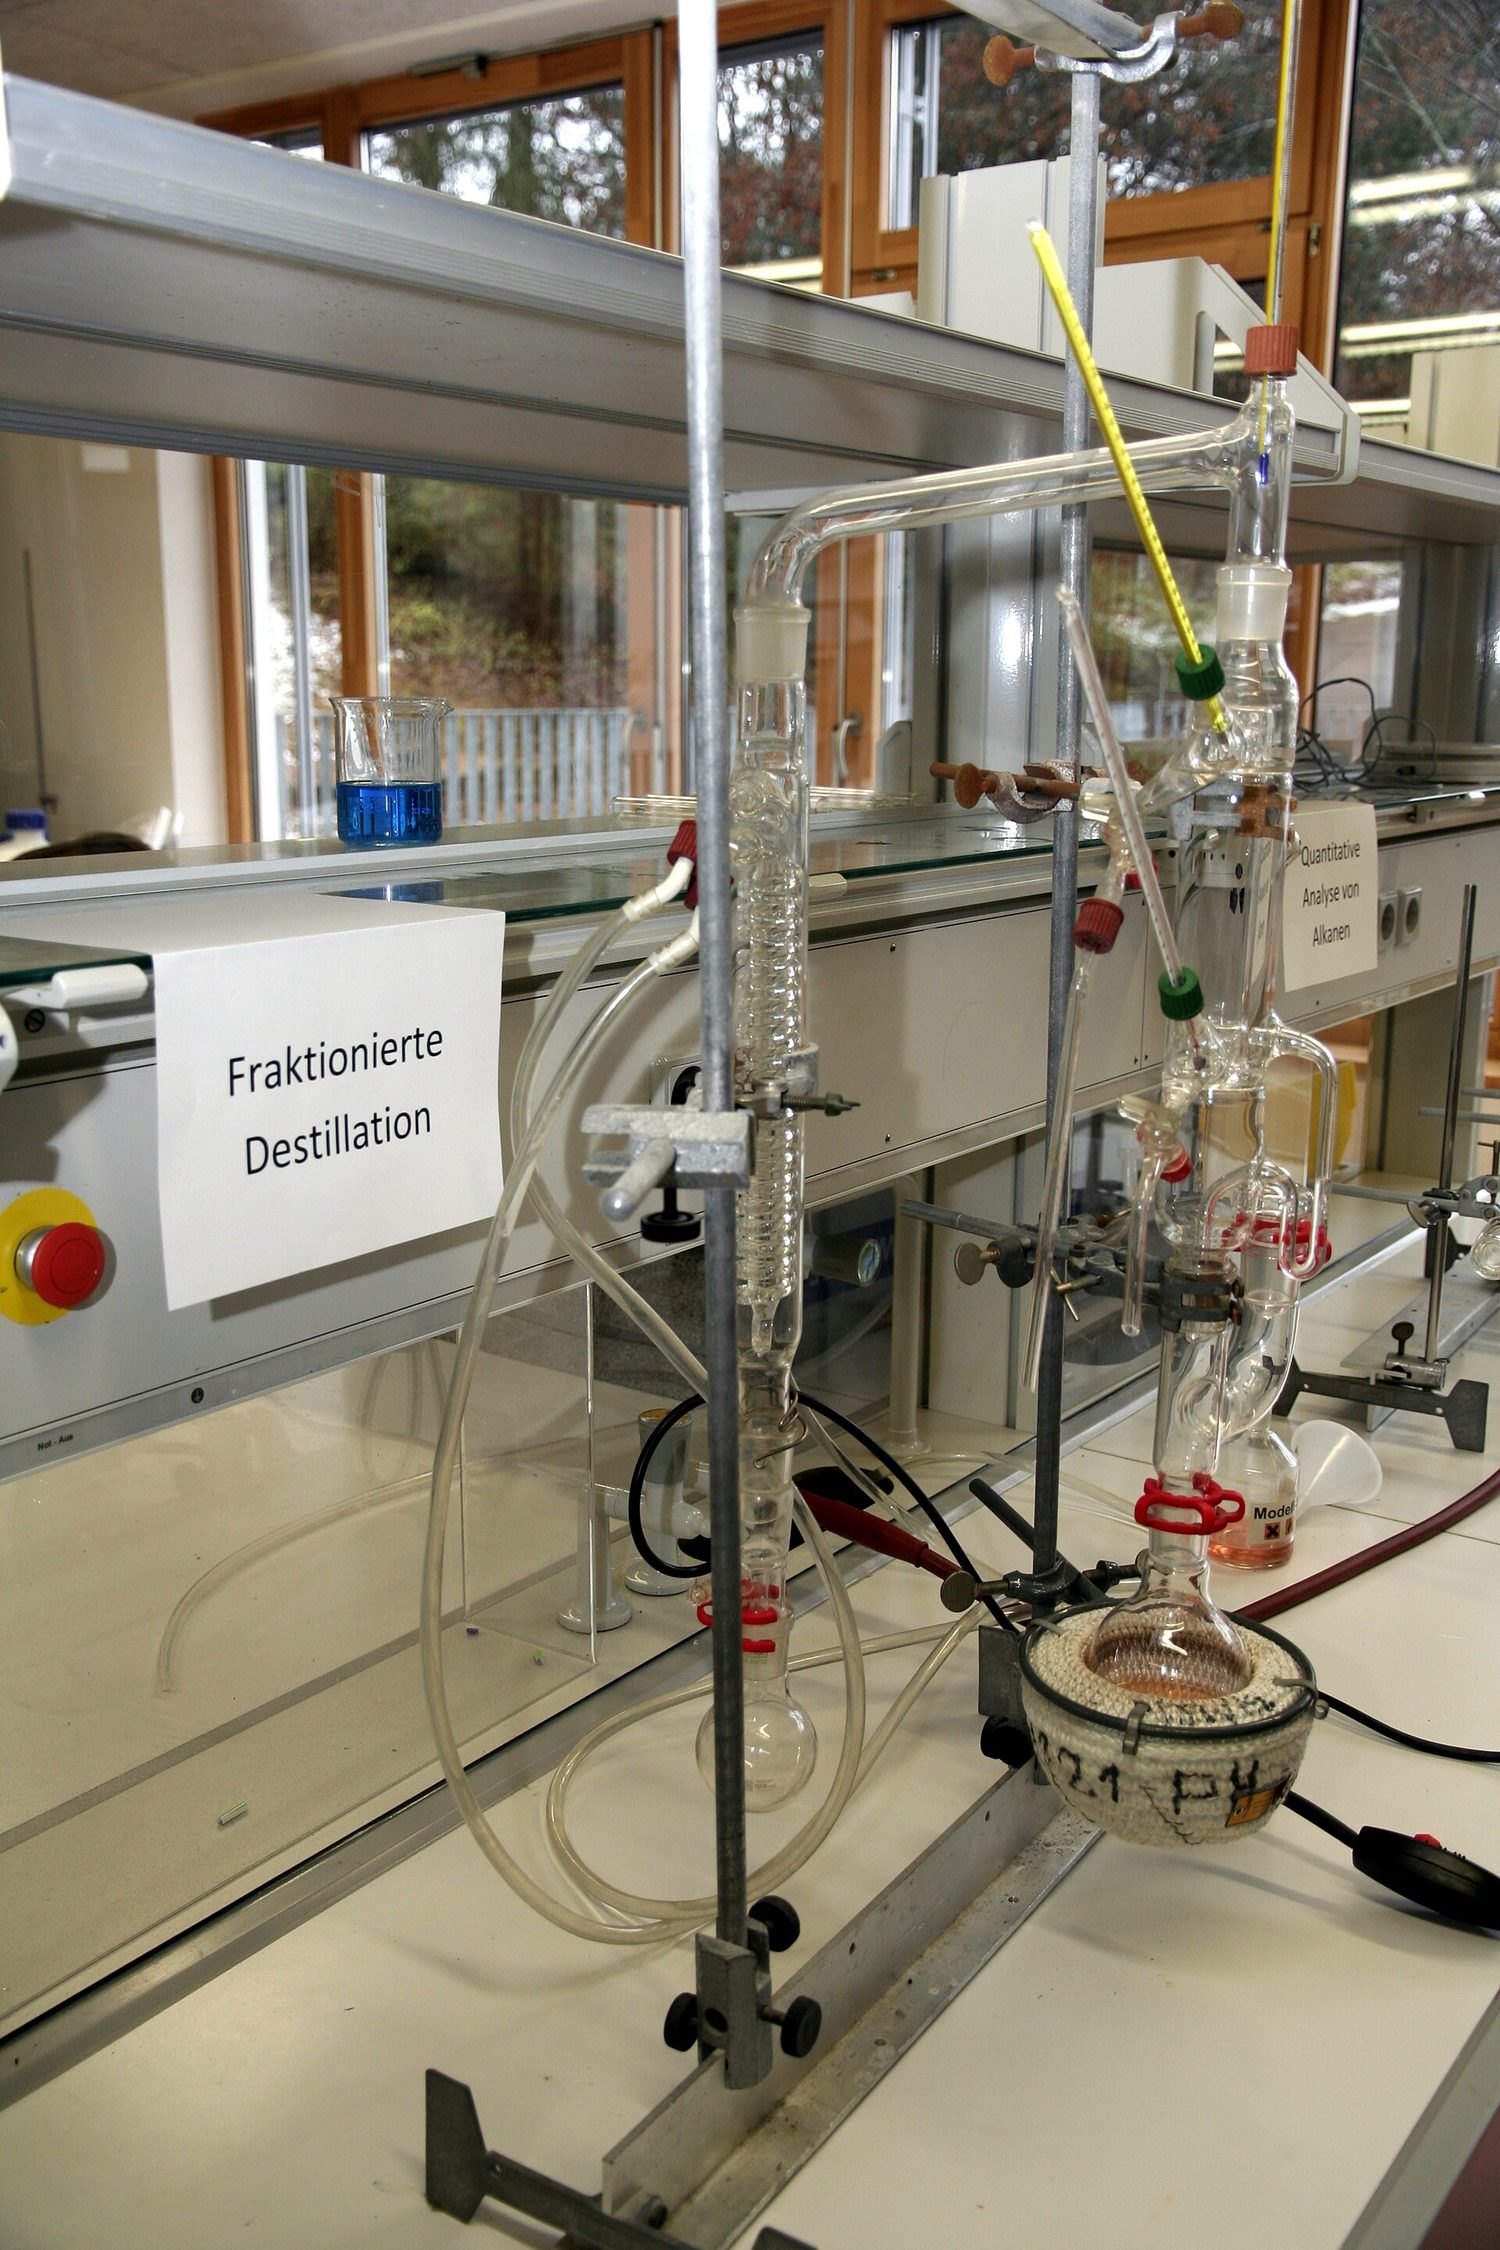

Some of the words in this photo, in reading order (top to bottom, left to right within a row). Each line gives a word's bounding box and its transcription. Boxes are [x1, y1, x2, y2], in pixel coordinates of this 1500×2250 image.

[1301, 840, 1360, 867] Quantitative
[1303, 883, 1339, 908] Analyse
[1342, 883, 1359, 900] von
[1313, 924, 1350, 946] Alkanen
[229, 1027, 443, 1097] Fraktionierte
[246, 1106, 431, 1175] Destillation
